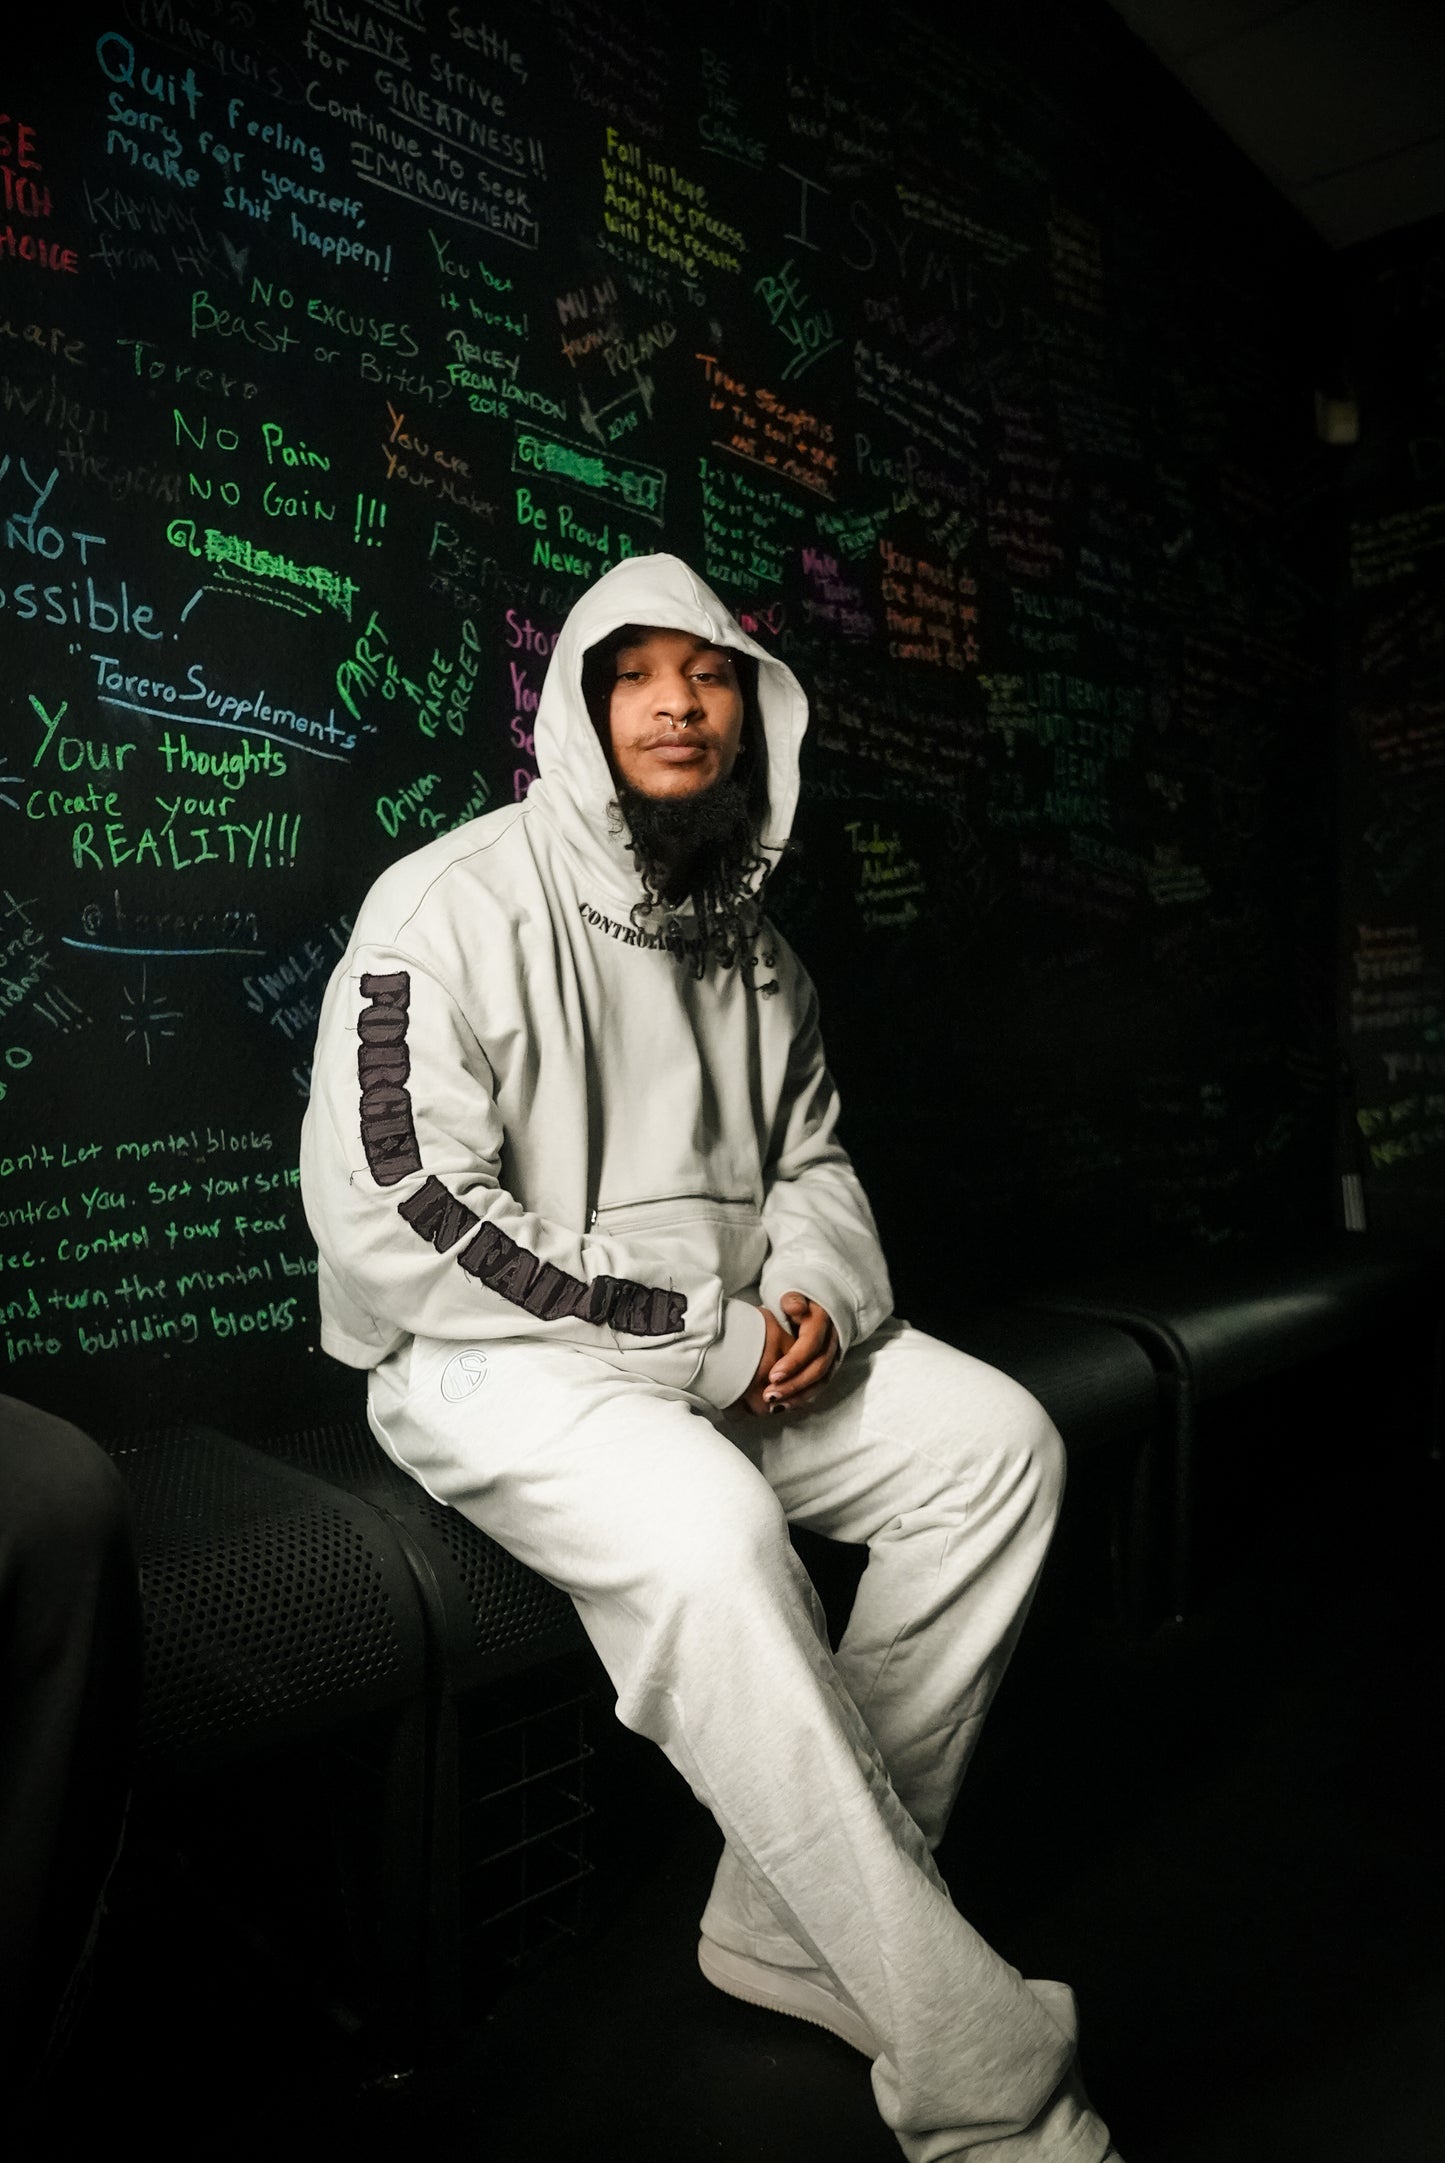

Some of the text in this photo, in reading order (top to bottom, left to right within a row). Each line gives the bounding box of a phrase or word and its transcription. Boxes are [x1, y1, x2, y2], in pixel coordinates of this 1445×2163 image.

[96, 30, 204, 120] Quit
[514, 486, 548, 531] Be
[0, 575, 204, 642] ssible!
[28, 693, 288, 791] Your thoughts
[0, 1143, 55, 1177] on't
[0, 1196, 71, 1229] ontrol
[280, 1251, 319, 1277] blo
